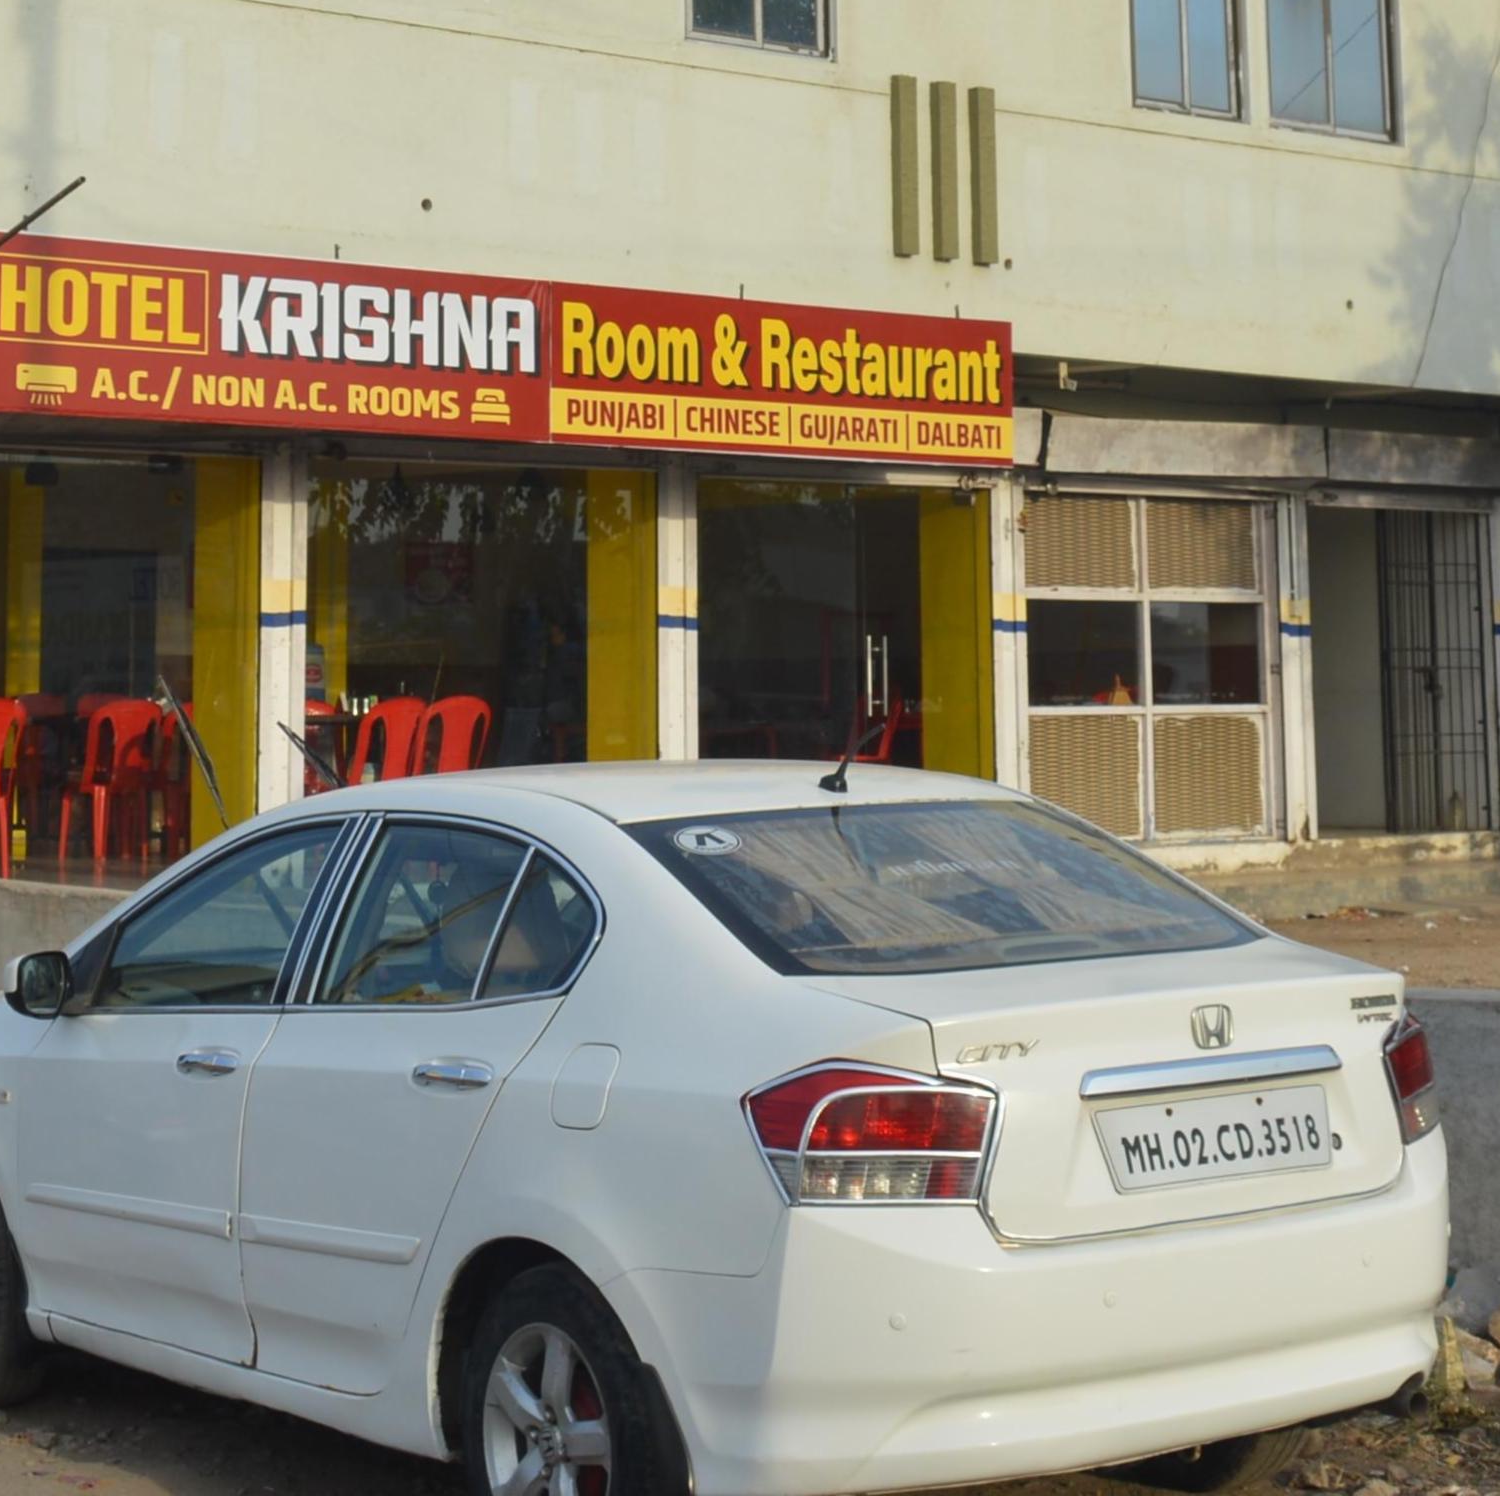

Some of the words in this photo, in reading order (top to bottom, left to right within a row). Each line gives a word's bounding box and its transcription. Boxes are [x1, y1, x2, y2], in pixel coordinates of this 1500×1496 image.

[0, 263, 200, 346] HOTEL
[219, 273, 537, 374] KRISHNA
[561, 300, 701, 384] Room
[711, 313, 749, 388] &
[760, 317, 1002, 404] Restaurant
[192, 374, 265, 409] NON
[274, 380, 338, 414] A.C.
[348, 384, 461, 421] ROOMS
[566, 398, 665, 433] PUNJABI
[686, 405, 781, 437] CHINESE
[799, 413, 899, 446] GUJARATI
[917, 420, 1002, 450] DALBATI
[956, 1038, 1041, 1065] CITY
[1121, 1113, 1321, 1175] MH.02.CD.3518
